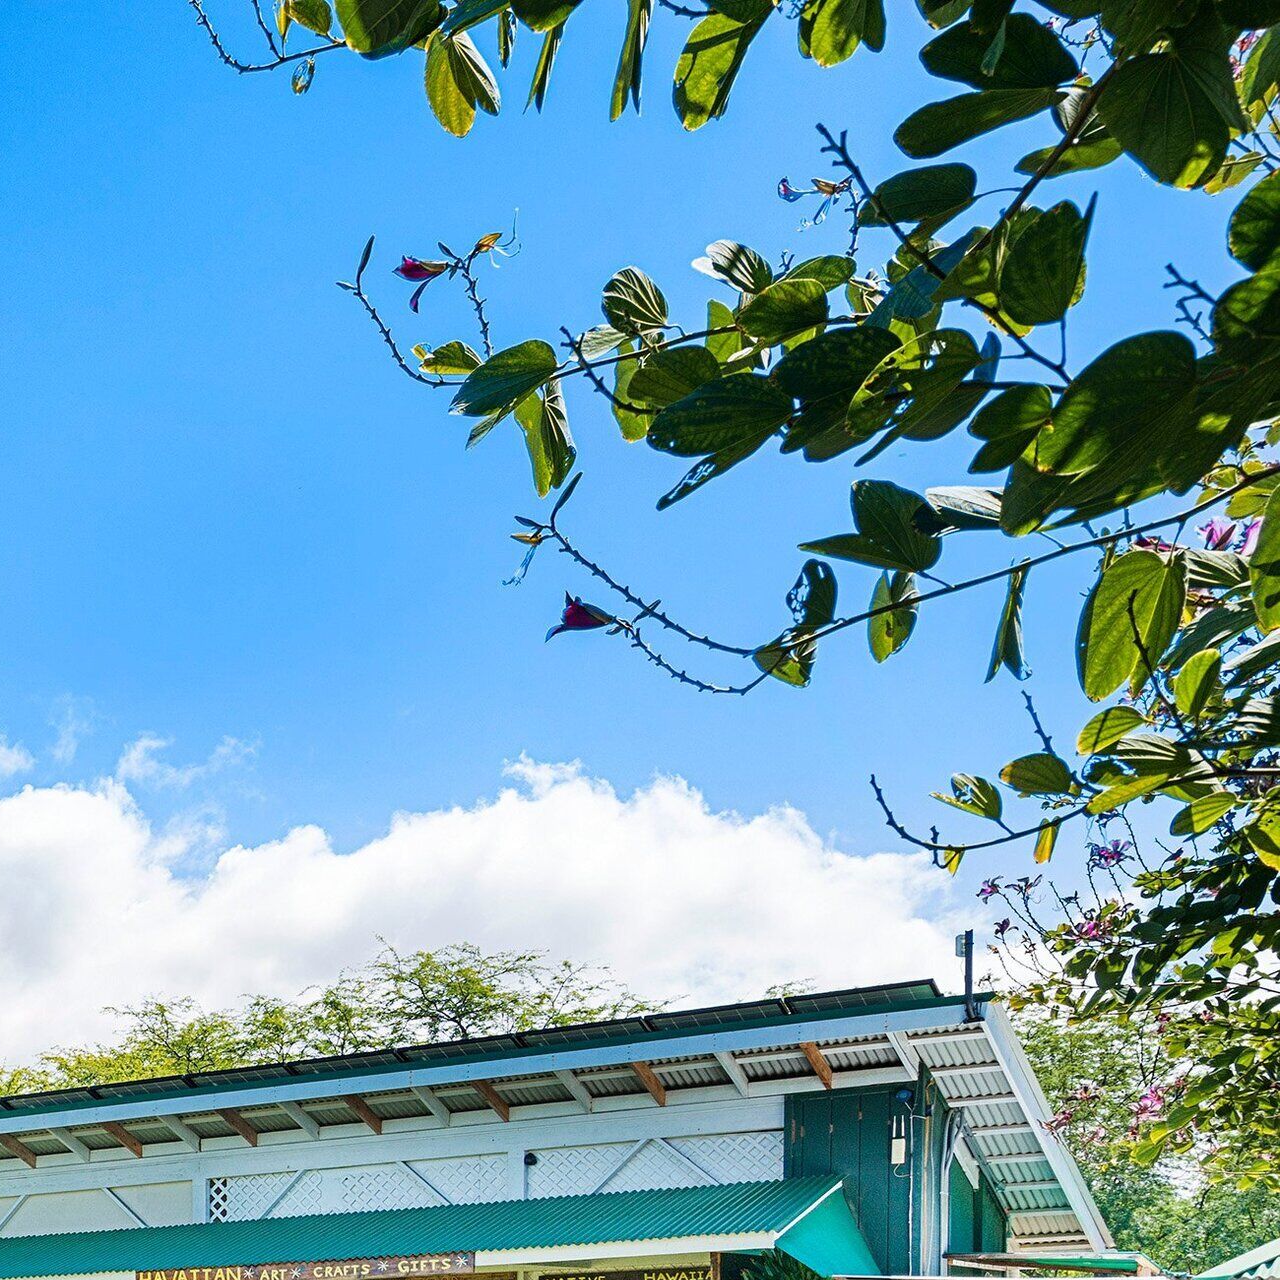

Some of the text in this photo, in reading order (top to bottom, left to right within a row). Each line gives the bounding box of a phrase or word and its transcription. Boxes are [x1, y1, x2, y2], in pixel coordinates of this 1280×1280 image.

[259, 1268, 288, 1280] ART
[313, 1263, 370, 1278] CRAFTS
[398, 1258, 451, 1274] GIFTS
